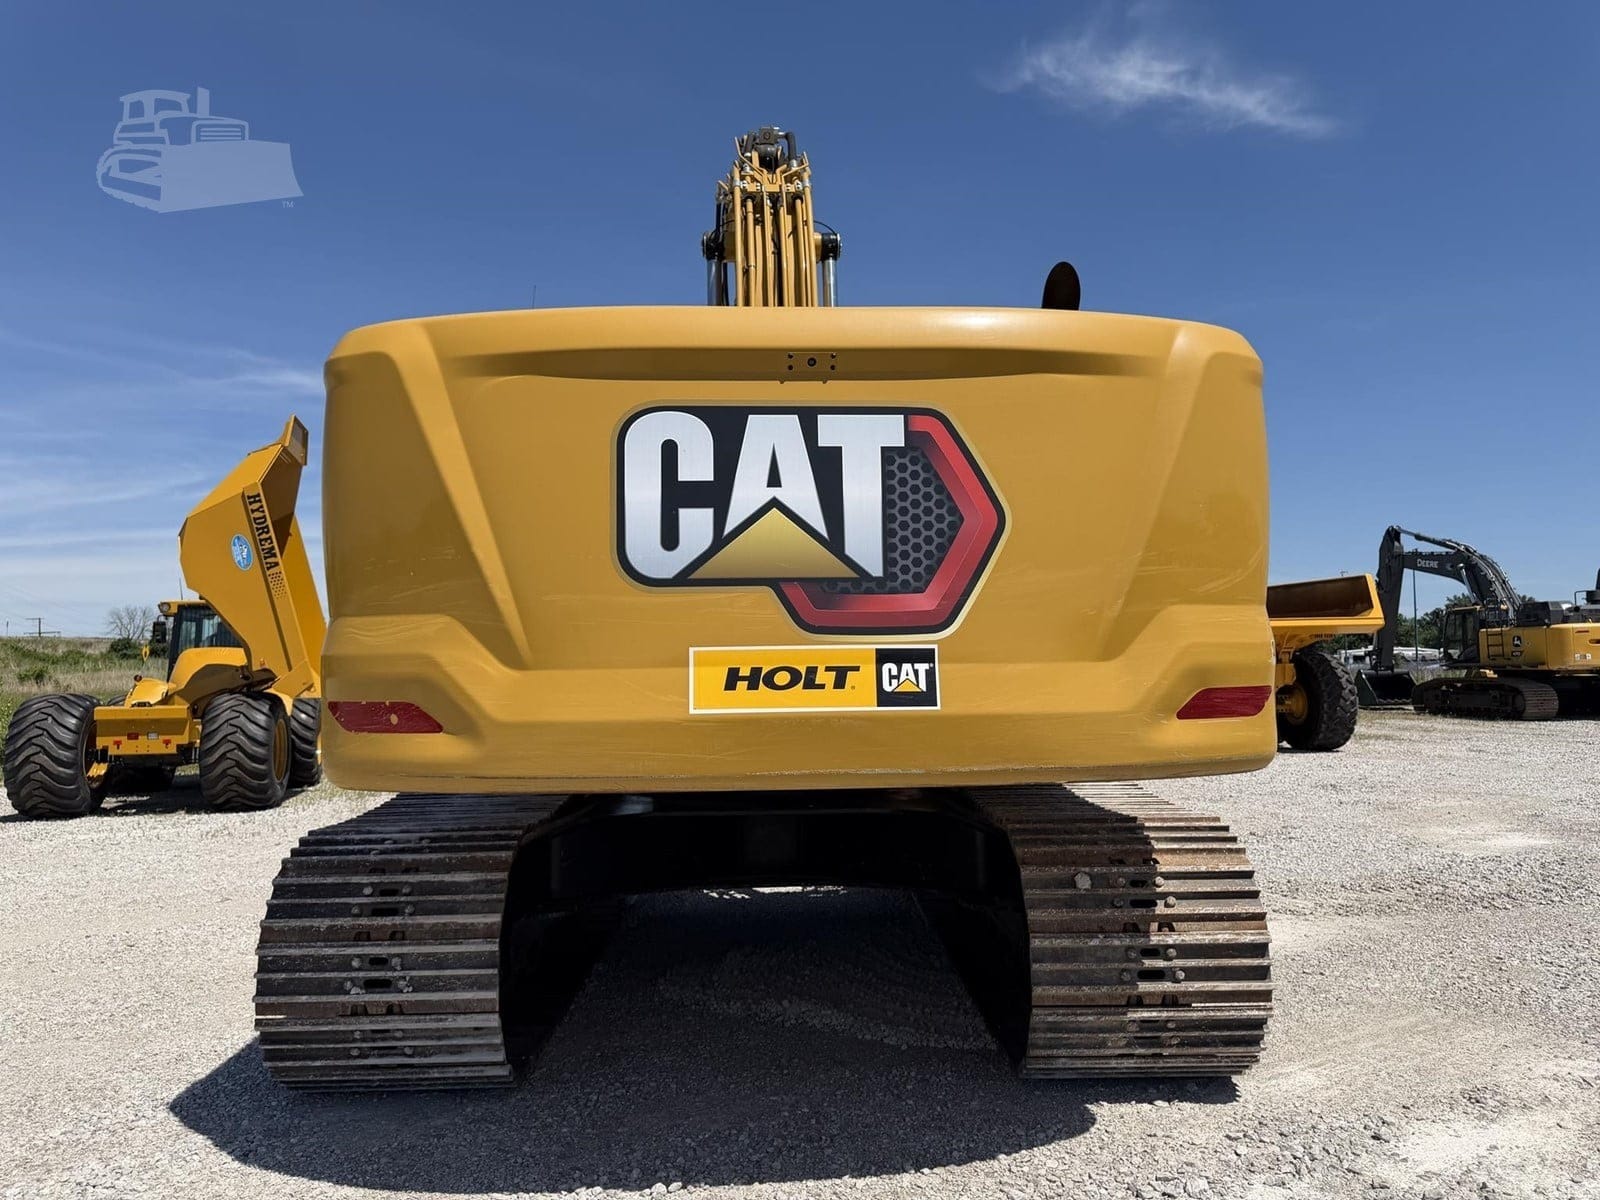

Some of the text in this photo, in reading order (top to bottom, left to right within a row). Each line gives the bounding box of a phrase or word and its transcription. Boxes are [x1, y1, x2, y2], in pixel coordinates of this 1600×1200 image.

[624, 411, 905, 579] CAT
[247, 492, 280, 571] HYDREMA
[1416, 558, 1439, 569] DEERE
[723, 662, 929, 692] HOLT CAT
